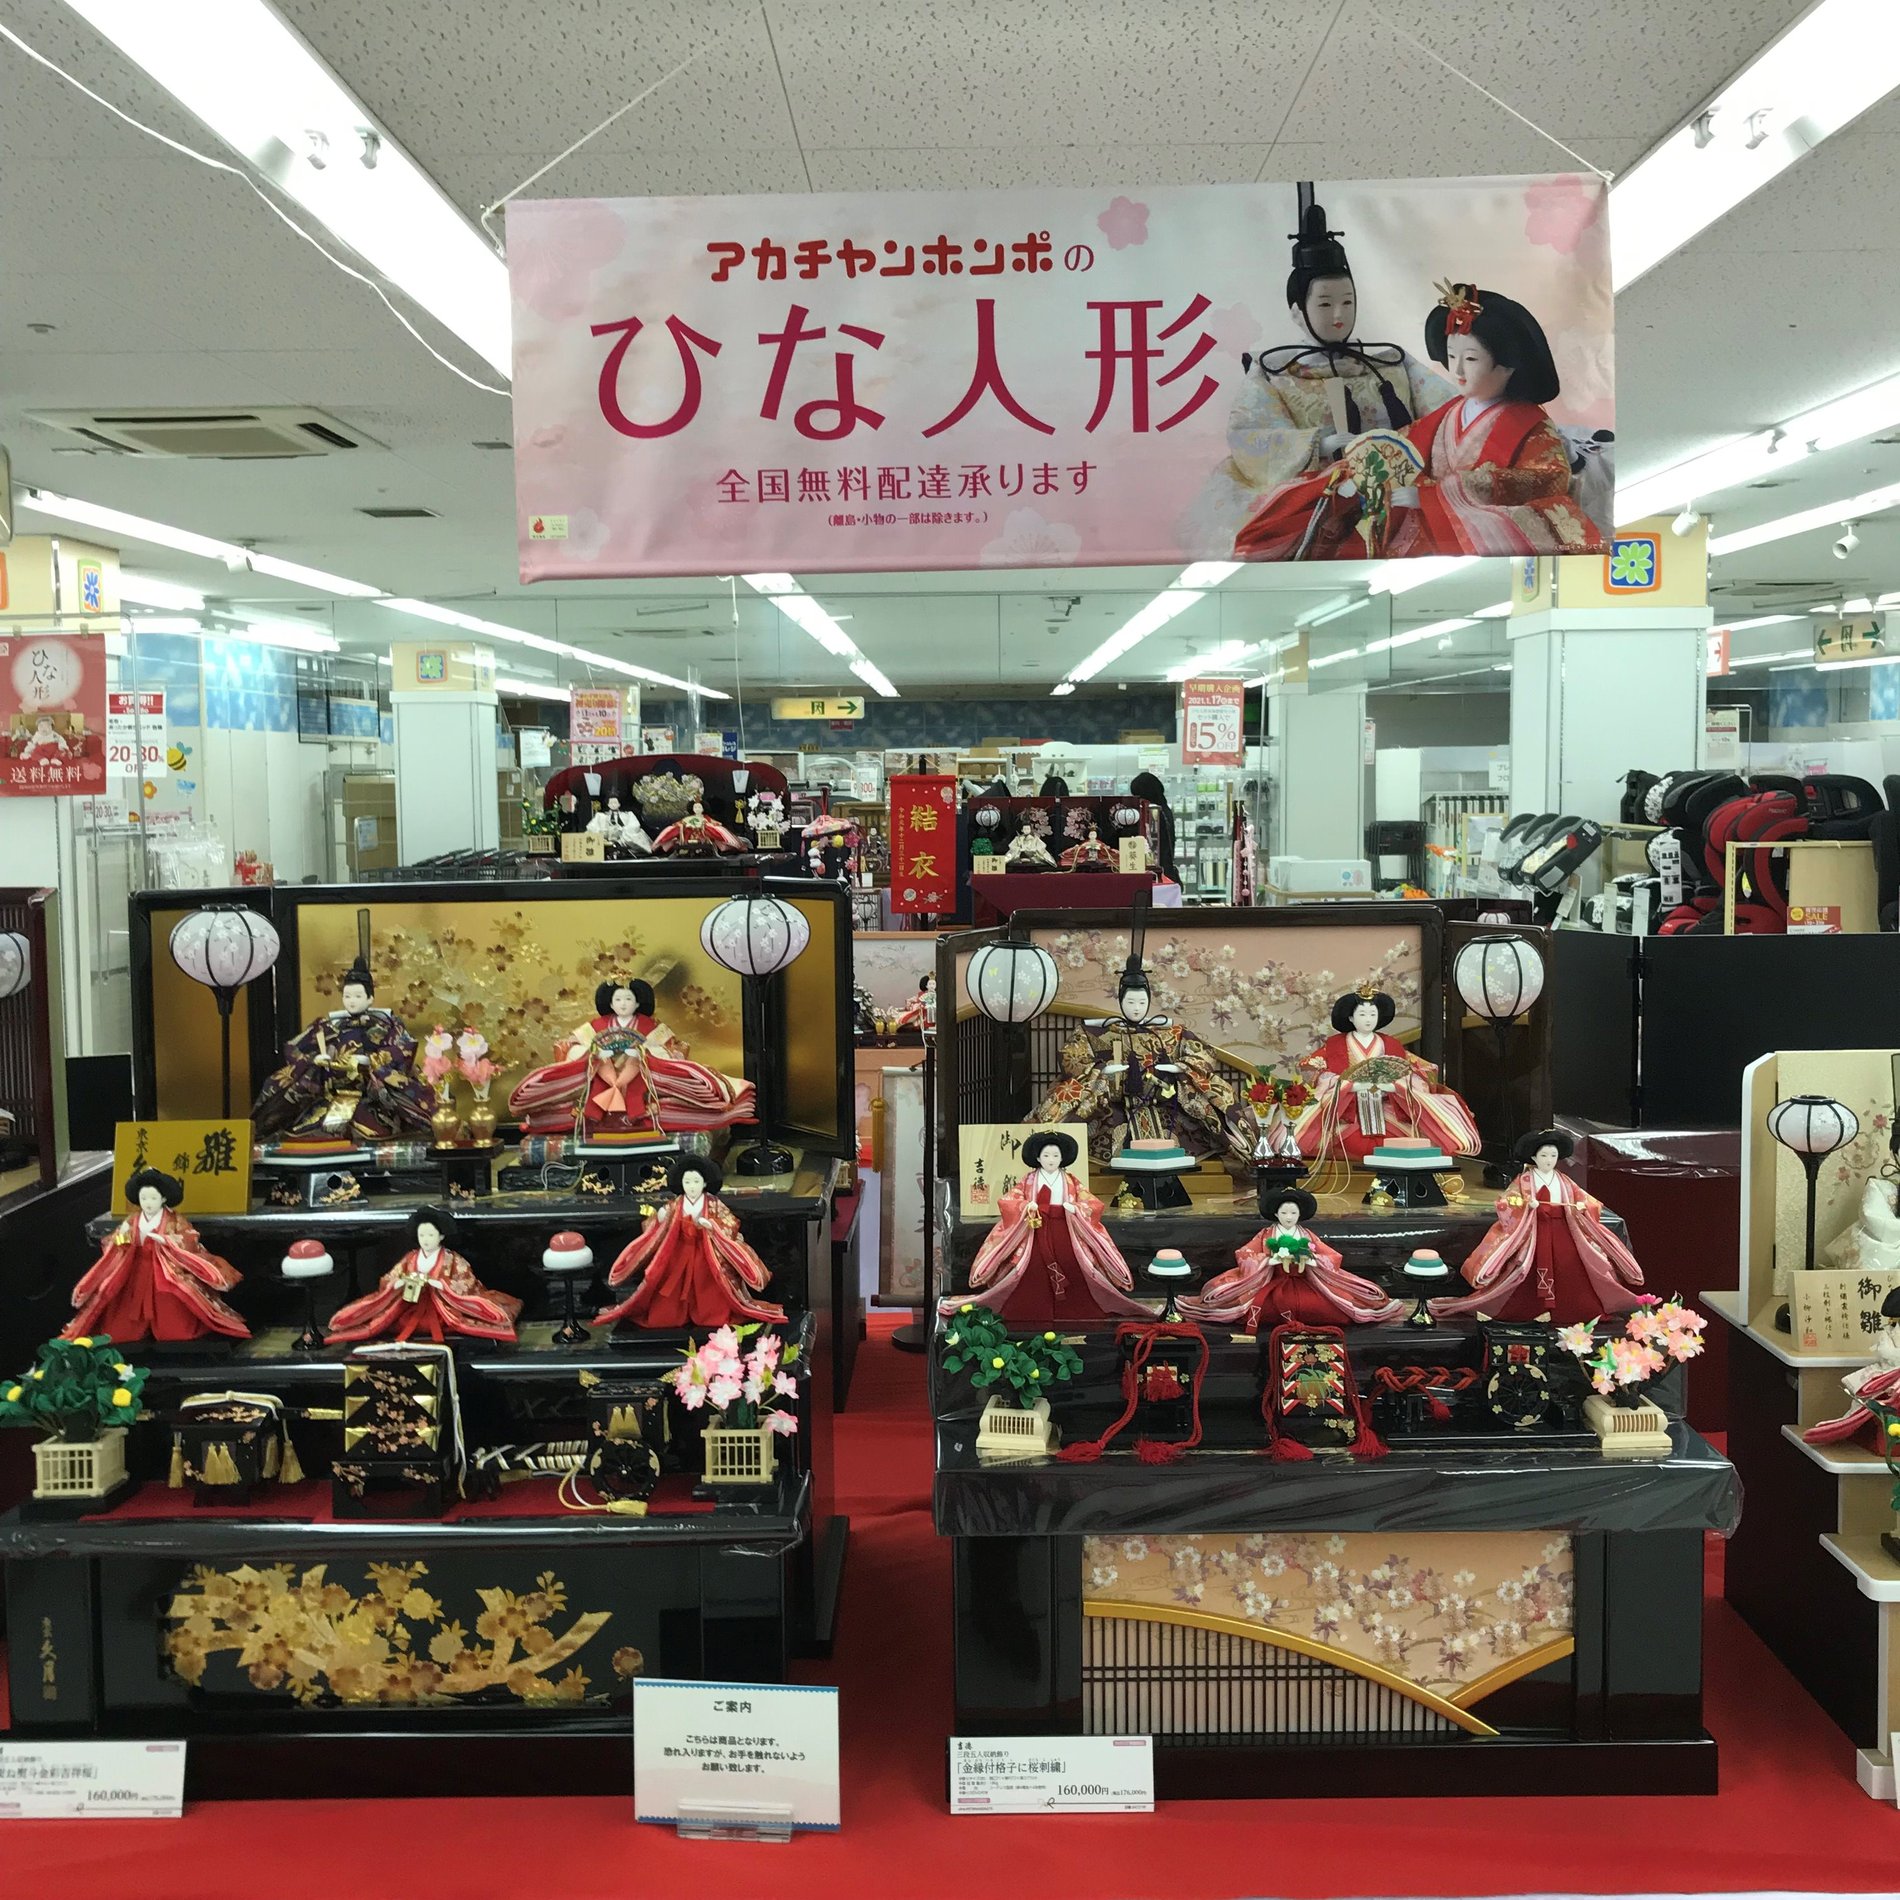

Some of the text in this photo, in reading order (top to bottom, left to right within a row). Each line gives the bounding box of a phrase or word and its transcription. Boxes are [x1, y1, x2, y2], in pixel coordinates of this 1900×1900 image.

[706, 230, 1096, 283] アカチャンホンポの
[590, 292, 1221, 440] ひな人形
[716, 461, 1098, 505] 全国無料配達承ります
[10, 766, 82, 784] 送料無料
[908, 804, 939, 880] 結衣
[713, 1700, 752, 1714] ご案内
[686, 1734, 780, 1747] こちらは商品となります。
[663, 1746, 806, 1761] 恐れ入りますが、お手を触れないよう
[701, 1762, 766, 1774] お願い致します。
[1057, 1784, 1109, 1796] 160,000円
